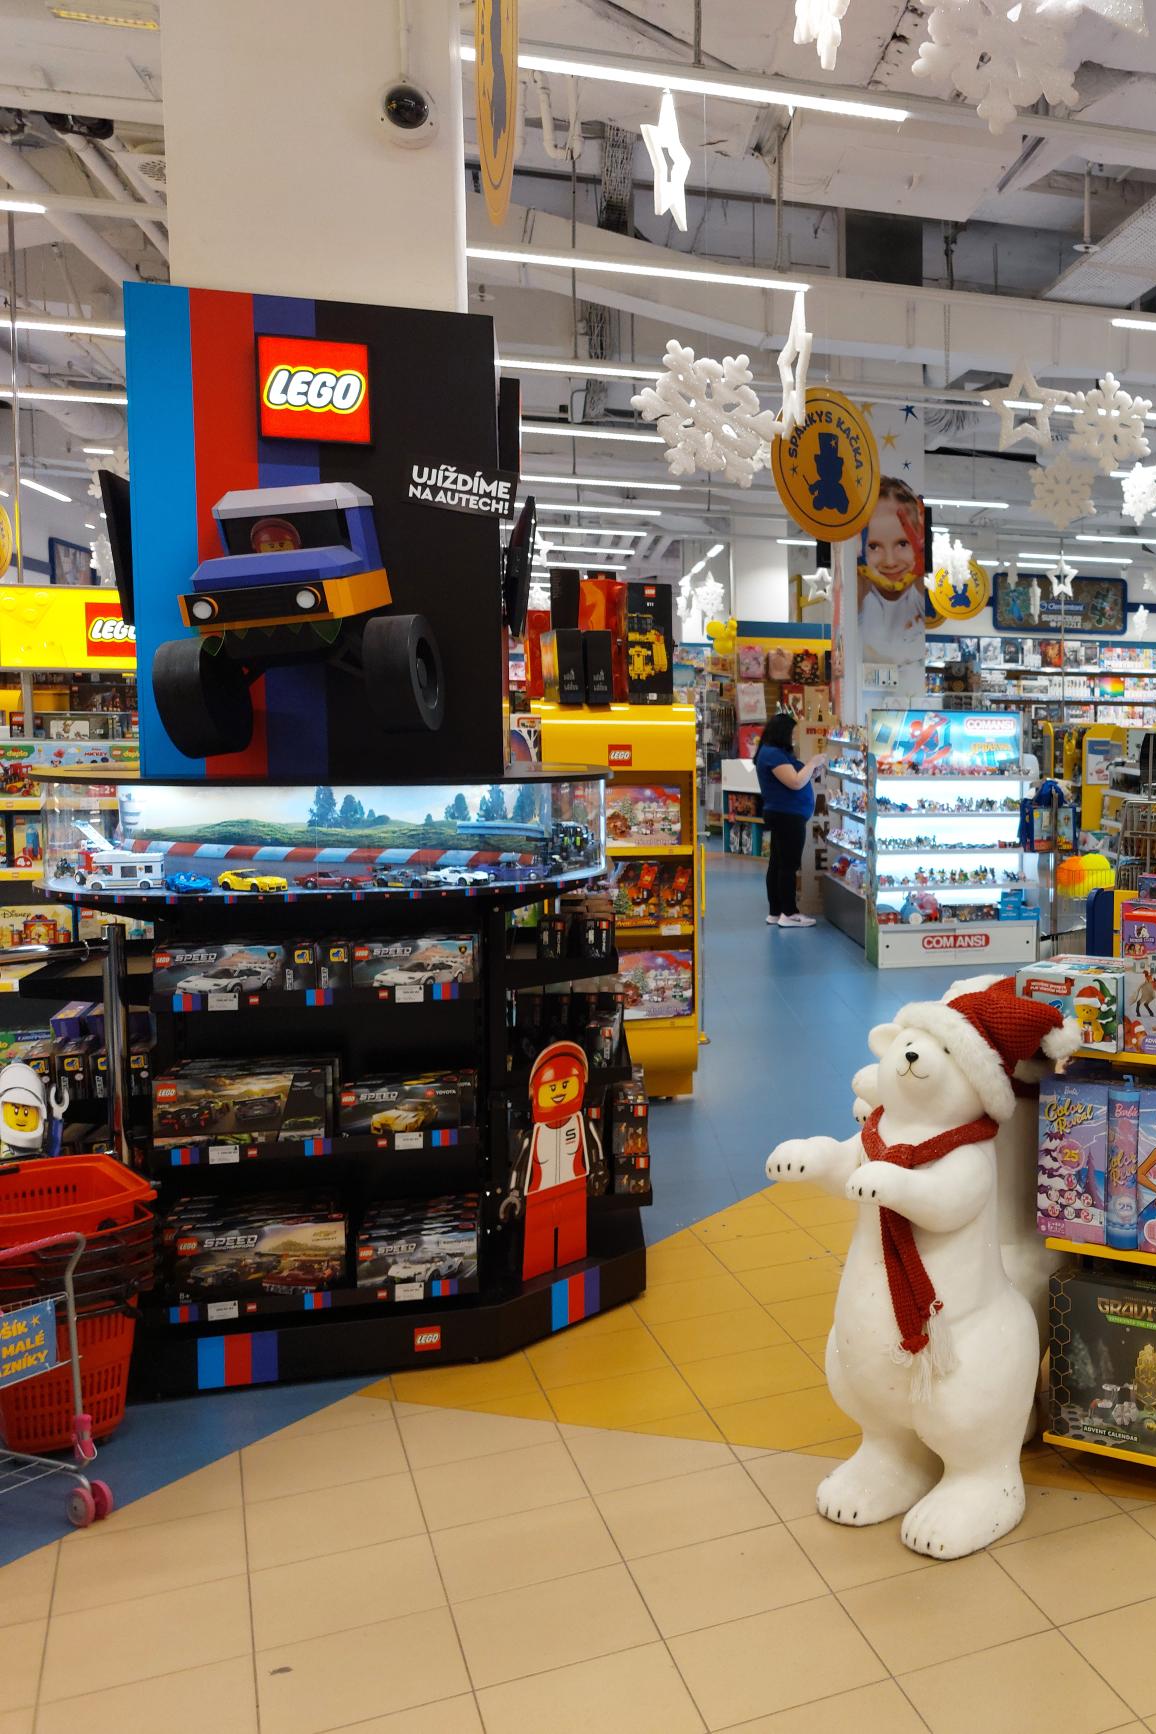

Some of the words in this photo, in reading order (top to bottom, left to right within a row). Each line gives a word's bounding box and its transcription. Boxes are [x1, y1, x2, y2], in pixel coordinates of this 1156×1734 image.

[265, 367, 364, 413] LEGO
[836, 417, 864, 470] KAČKA
[412, 464, 511, 499] UJÍŽDÍME
[408, 484, 432, 501] NA
[434, 491, 509, 515] AUTECH!
[965, 719, 1015, 731] COMANSI
[609, 751, 630, 760] LEGO
[922, 935, 987, 949] COMANSI
[174, 952, 217, 963] SPEED
[373, 946, 412, 957] SPEED
[155, 956, 170, 964] LEGO
[158, 1089, 176, 1098] LEGO
[359, 1091, 398, 1103] SPEED
[435, 1089, 457, 1097] TOYOTA
[1044, 1098, 1086, 1121] Color
[1114, 1103, 1139, 1118] Barbie
[1055, 1103, 1094, 1133] Reveal
[1062, 1149, 1080, 1161] 25
[179, 1242, 197, 1250] LEGO
[203, 1235, 258, 1248] SPEED
[377, 1243, 416, 1256] SPEED
[0, 1319, 28, 1340] ŠÍK
[2, 1329, 45, 1359] MALÉ
[415, 1333, 440, 1345] LEGO
[0, 1350, 48, 1377] ZNÍKY
[1083, 1425, 1106, 1437] ADVENT
[1107, 1430, 1138, 1443] CALENDAR
